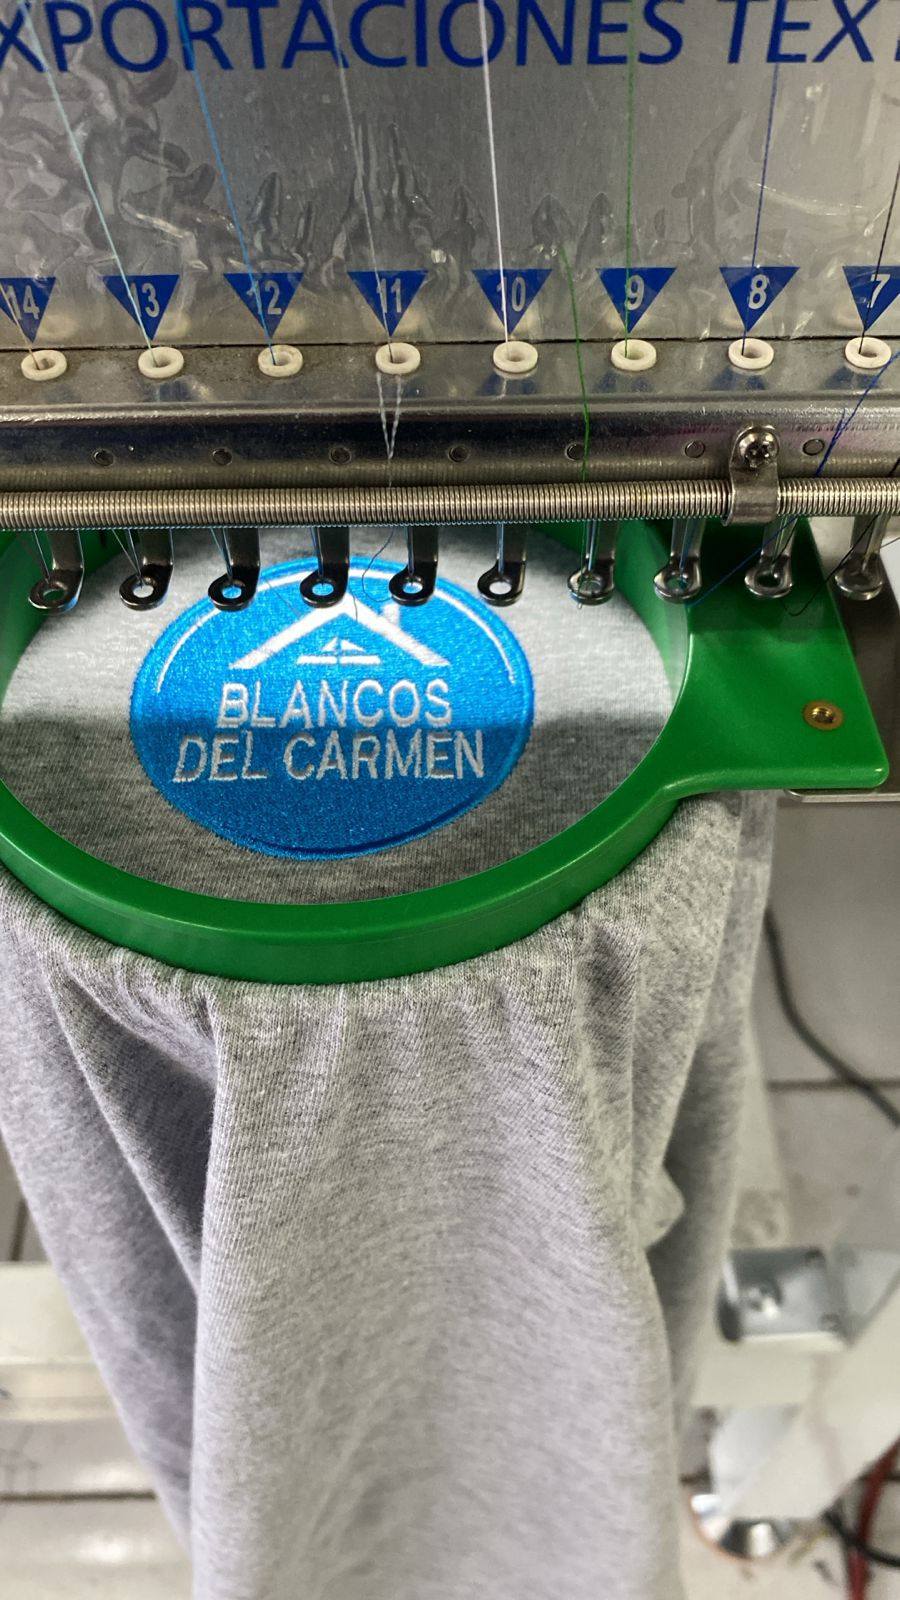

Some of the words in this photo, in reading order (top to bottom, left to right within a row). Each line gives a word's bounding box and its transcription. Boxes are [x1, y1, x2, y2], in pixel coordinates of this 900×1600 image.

[0, 0, 684, 73] XPORTACIONES
[716, 0, 900, 63] TEX
[5, 285, 40, 320] 14
[246, 280, 282, 315] 12
[376, 278, 402, 313] 11
[496, 276, 526, 312] 10
[624, 274, 645, 311] 9
[748, 273, 769, 310] 8
[866, 273, 891, 309] 7
[216, 678, 453, 729] BLANCOS
[172, 731, 268, 783] DEL
[281, 729, 485, 781] CARMEN
